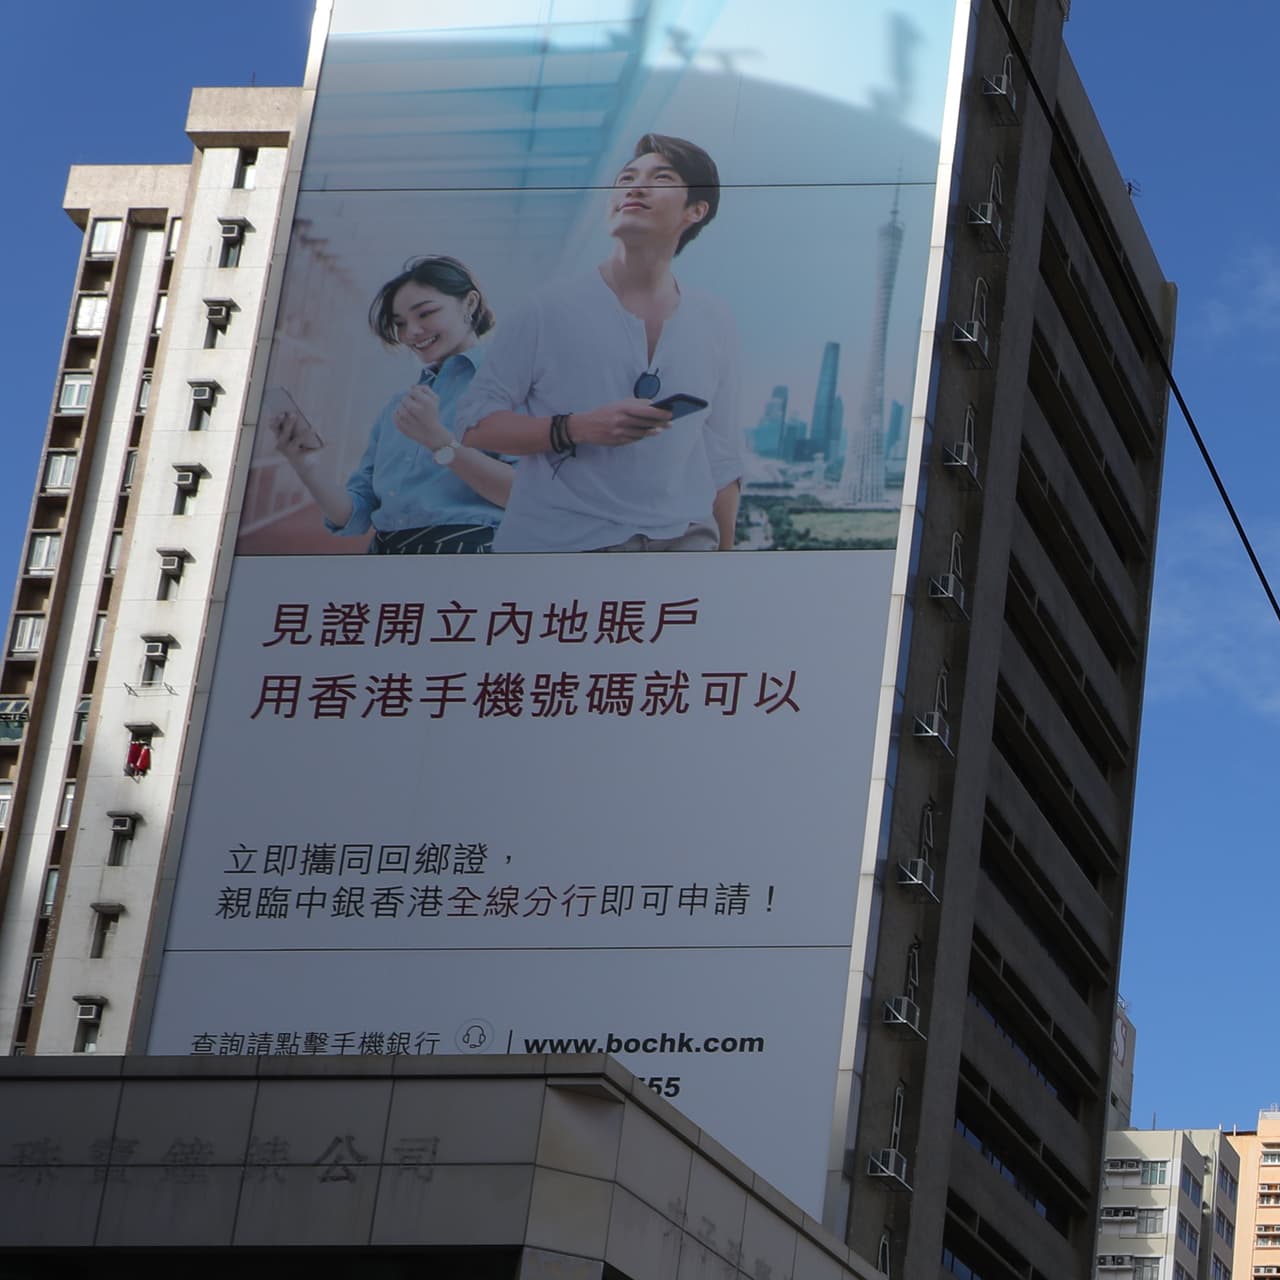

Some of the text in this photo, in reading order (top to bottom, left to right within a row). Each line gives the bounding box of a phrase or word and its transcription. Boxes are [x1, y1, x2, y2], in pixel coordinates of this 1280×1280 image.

[250, 669, 802, 721] 用香港手機號碼就可以
[524, 1033, 765, 1054] www.bochk.com
